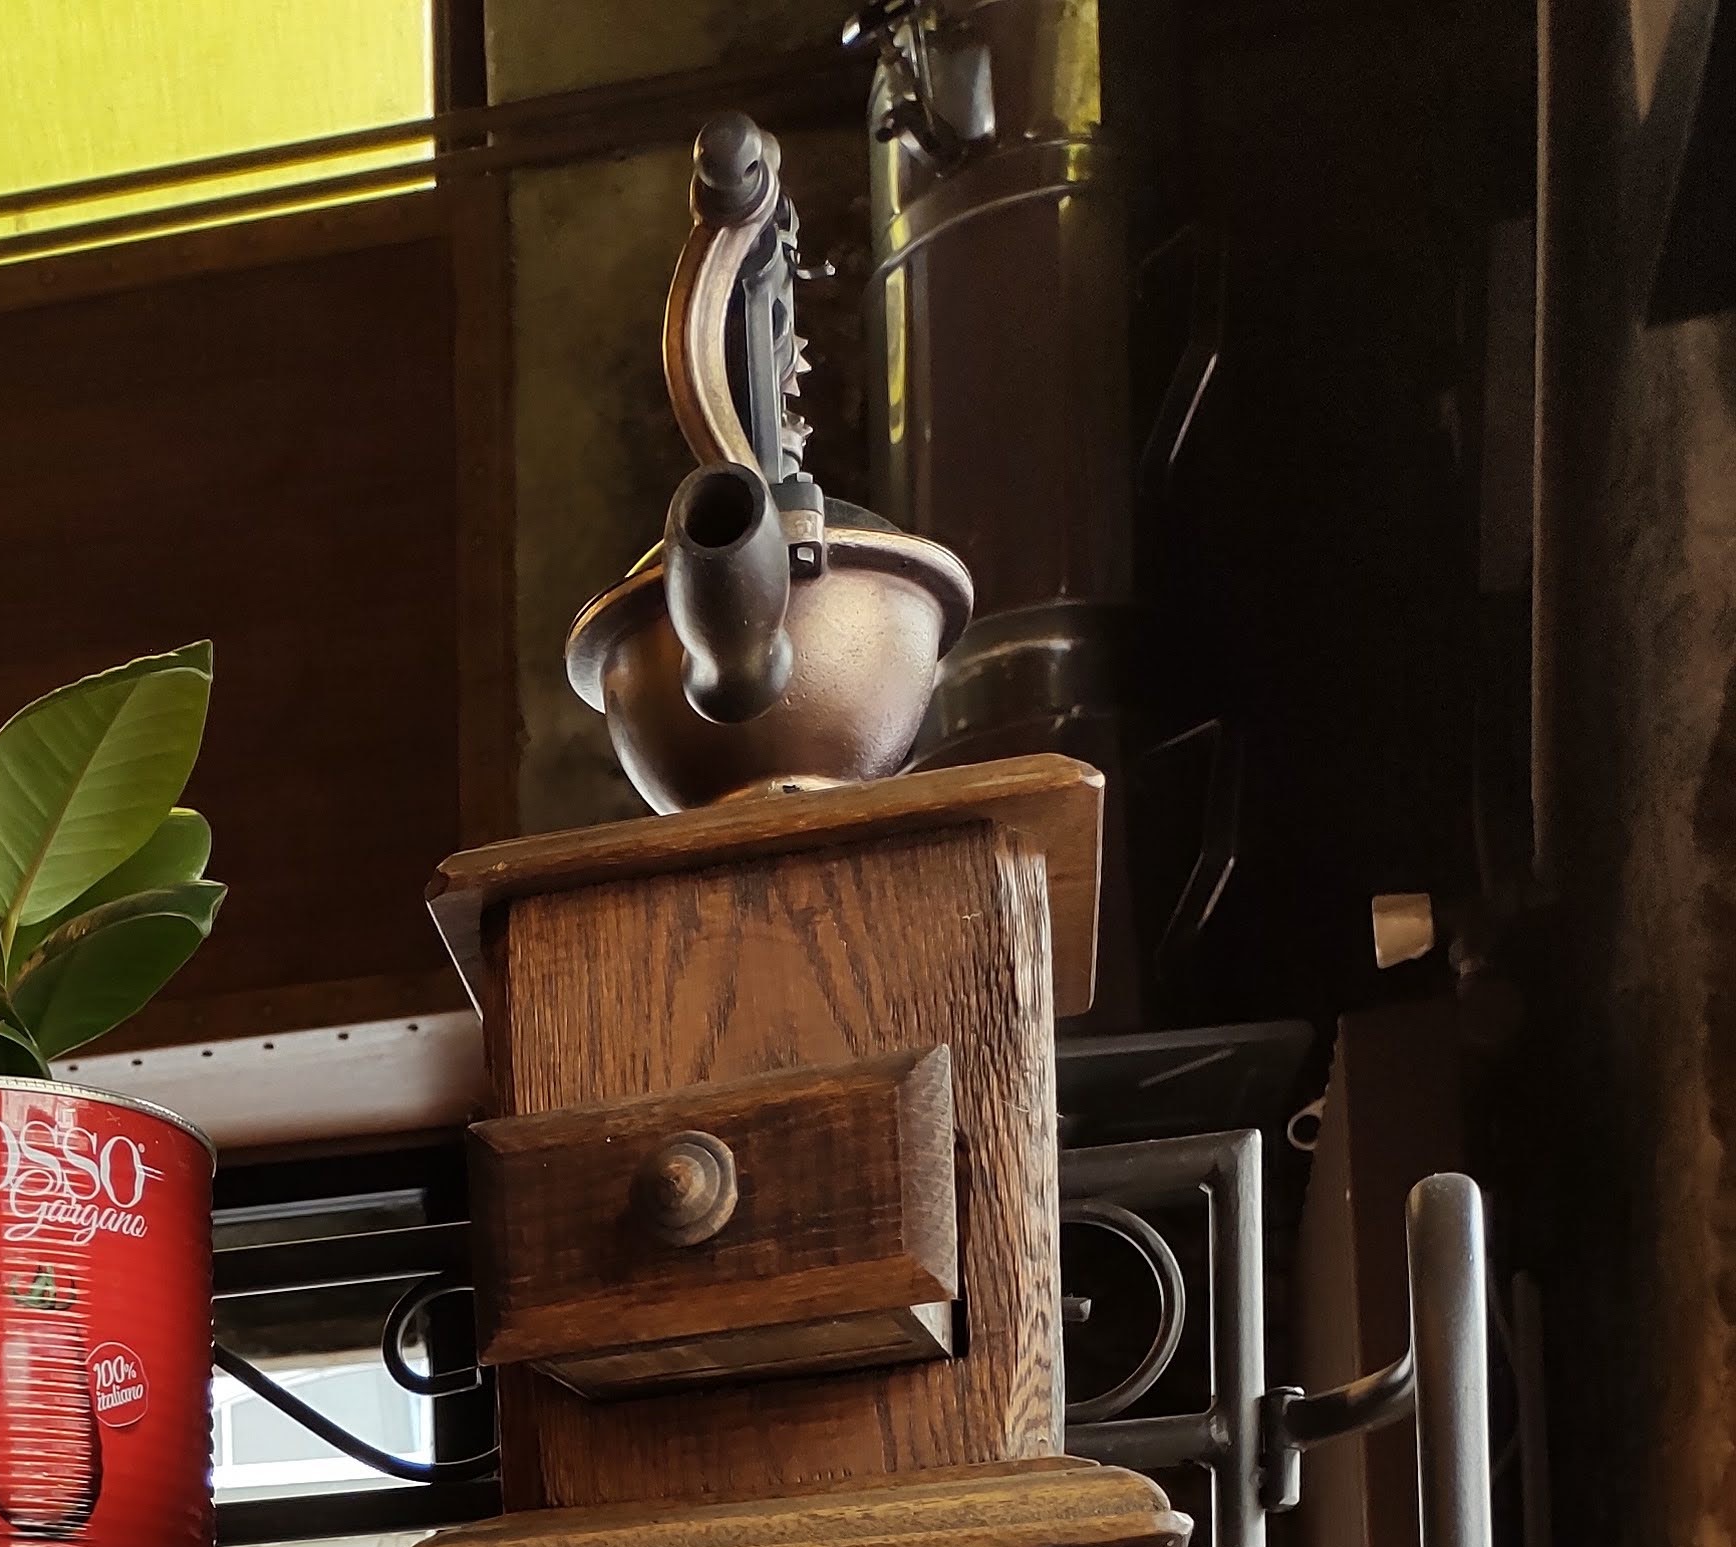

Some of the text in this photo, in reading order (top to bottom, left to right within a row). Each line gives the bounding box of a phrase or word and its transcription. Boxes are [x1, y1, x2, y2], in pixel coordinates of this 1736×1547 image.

[4, 1169, 149, 1246] Gargano
[93, 1355, 137, 1390] 100%
[96, 1384, 144, 1411] italiano
